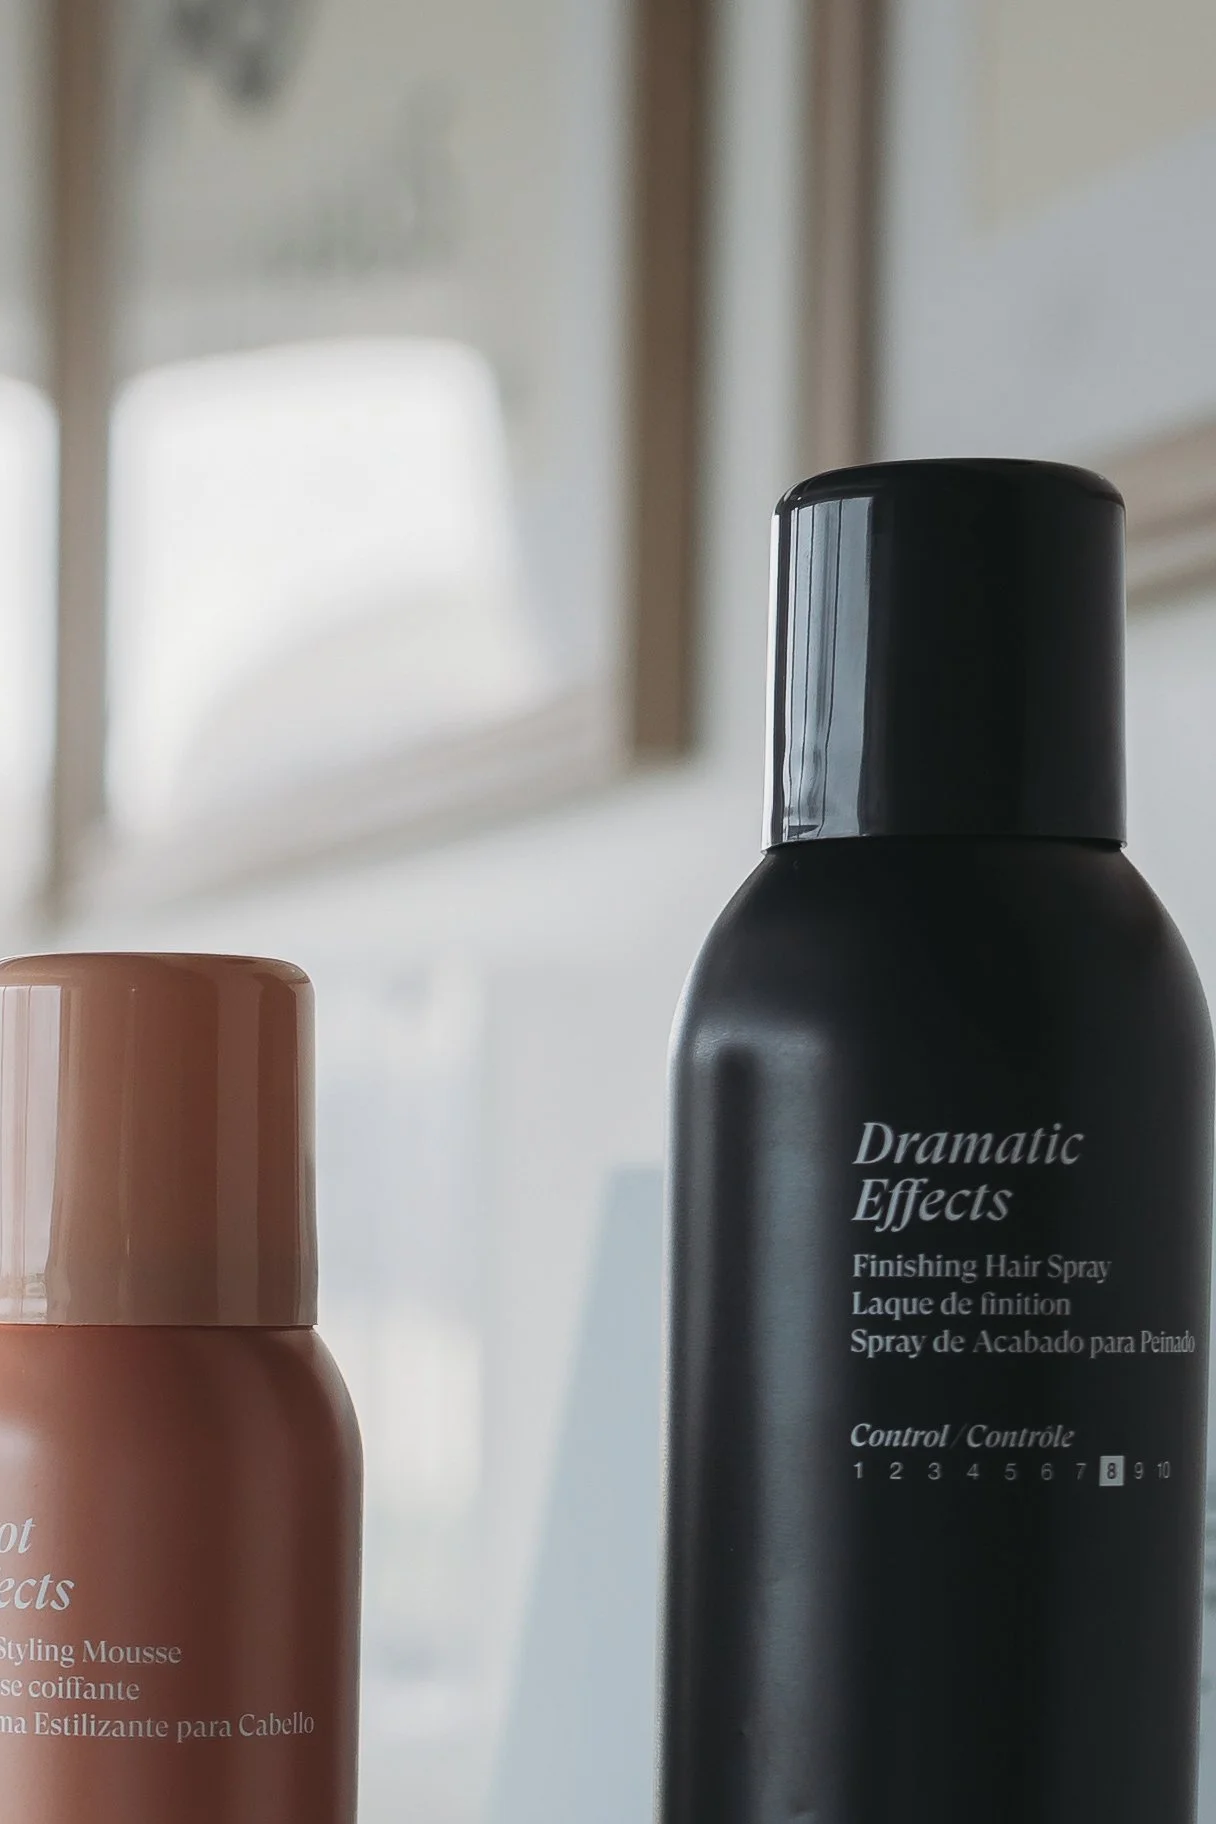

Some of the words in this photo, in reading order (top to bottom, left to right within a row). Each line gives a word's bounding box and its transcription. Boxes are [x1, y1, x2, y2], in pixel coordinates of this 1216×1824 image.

[852, 1121, 1086, 1165] Dramatic
[851, 1177, 1013, 1233] Effects
[852, 1253, 977, 1284] Finishing
[985, 1254, 1042, 1279] Hair
[1047, 1253, 1112, 1284] Spray
[851, 1291, 934, 1320] Laque
[940, 1291, 973, 1316] de
[980, 1291, 1072, 1317] finition
[850, 1328, 927, 1358] Spray
[933, 1328, 966, 1354] de
[973, 1329, 1084, 1355] Acabado
[1090, 1334, 1135, 1359] para
[1141, 1329, 1196, 1355] Peinado
[853, 1461, 864, 1480] 1
[889, 1461, 905, 1480] 2
[927, 1462, 944, 1481] 3
[966, 1462, 981, 1481] 4
[1004, 1462, 1018, 1481] 5
[1040, 1462, 1054, 1481] 6
[1075, 1462, 1087, 1480] 7
[1134, 1461, 1145, 1480] 9
[1157, 1460, 1172, 1480] 10
[83, 1640, 183, 1664] Mousse
[29, 1675, 140, 1701] coiffante
[34, 1712, 169, 1738] Estilizante
[178, 1718, 233, 1743] para
[239, 1711, 315, 1738] Cabello
